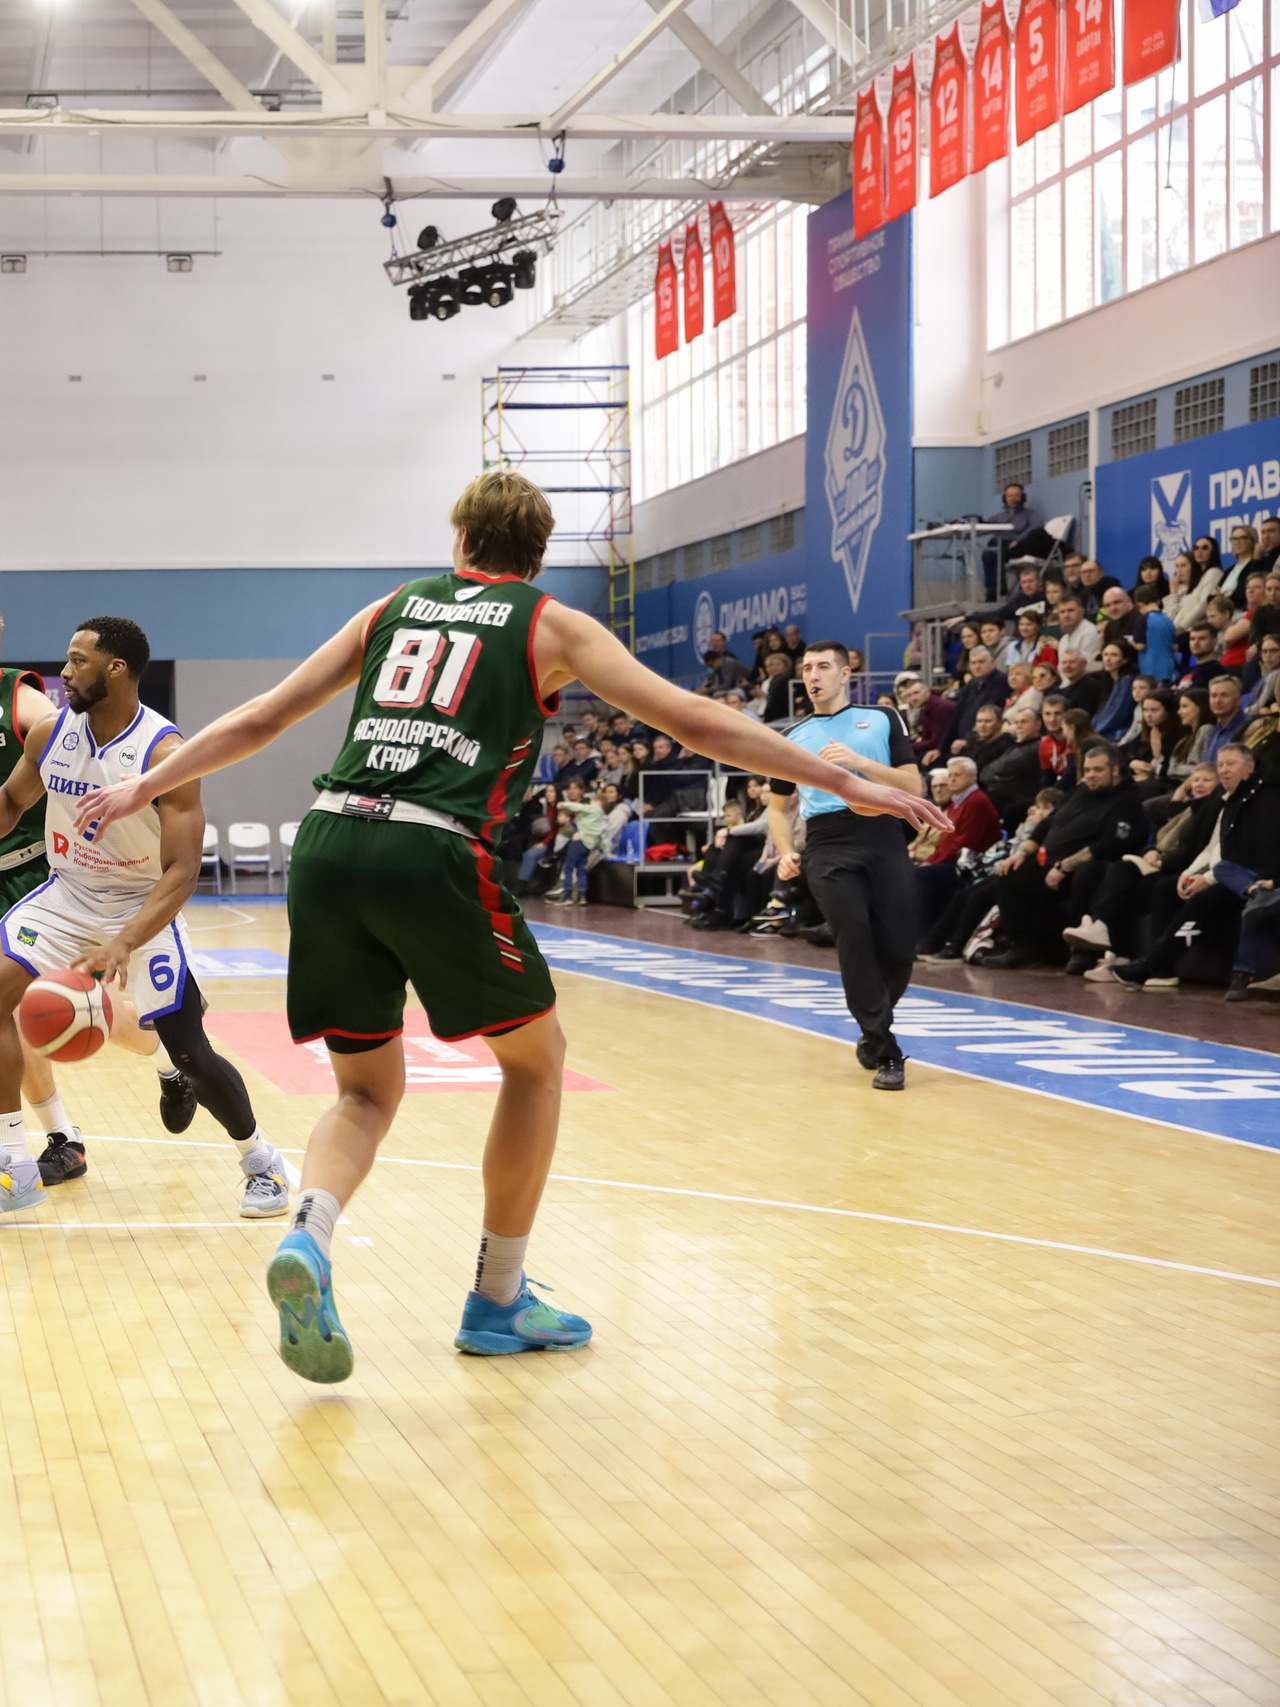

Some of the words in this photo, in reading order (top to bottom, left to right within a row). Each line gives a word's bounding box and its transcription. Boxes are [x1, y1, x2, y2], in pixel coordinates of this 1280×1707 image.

[1029, 16, 1044, 66] 5
[981, 46, 1003, 98] 14
[936, 78, 958, 128] 12
[861, 134, 873, 173] 4
[894, 108, 912, 155] 15
[400, 595, 513, 628] ТЮЛЮБАЕВ
[720, 586, 789, 642] ДИНАМО
[373, 627, 483, 717] 81
[365, 745, 421, 773] КРАЙ
[148, 954, 173, 990] 6
